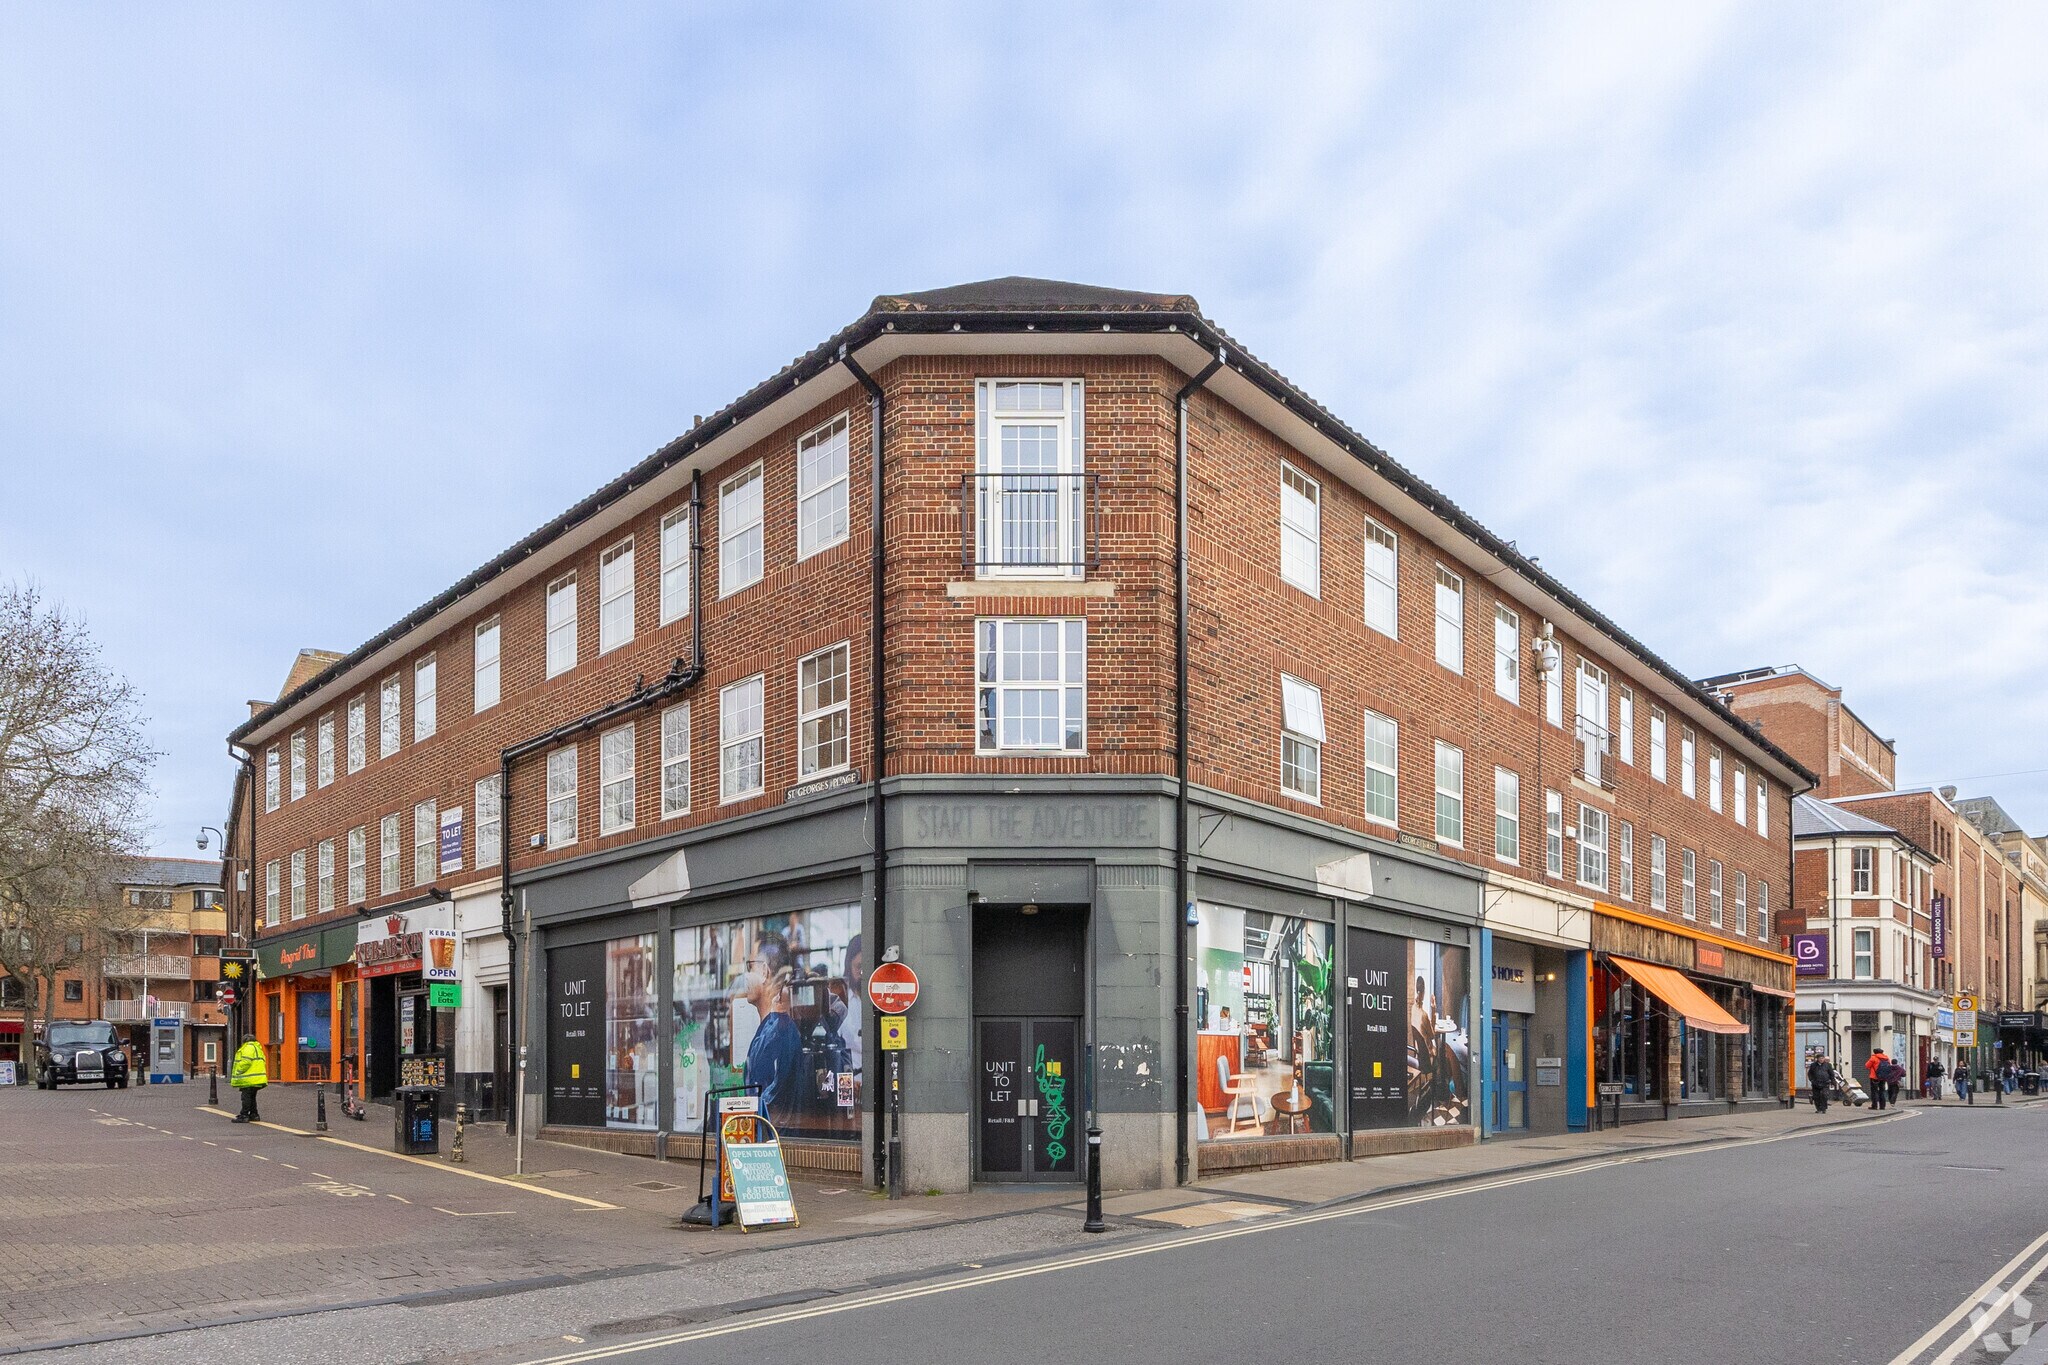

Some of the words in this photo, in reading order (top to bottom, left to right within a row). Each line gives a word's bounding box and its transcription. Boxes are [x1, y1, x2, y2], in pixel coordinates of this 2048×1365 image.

[787, 790, 796, 800] ST
[797, 781, 829, 797] GEORGES
[832, 772, 857, 788] PLACE
[916, 804, 979, 840] START
[985, 804, 1023, 840] THE
[442, 829, 451, 840] TO
[451, 826, 462, 837] LET
[1401, 834, 1420, 846] GEORGE
[429, 929, 456, 937] KEBAB
[355, 936, 398, 964] KEBAB
[400, 931, 423, 957] KIN
[429, 968, 457, 978] OPEN
[1365, 968, 1389, 987] UNIT
[564, 979, 587, 996] UNIT
[437, 990, 454, 998] Uber
[1360, 992, 1374, 1010] TO
[1376, 994, 1393, 1011] LET
[560, 1002, 573, 1018] TO
[575, 1001, 591, 1017] LET
[985, 1061, 1016, 1072] UNIT
[992, 1076, 1010, 1087] TO
[990, 1091, 1011, 1102] LET
[731, 1150, 752, 1158] OPEN
[753, 1150, 777, 1158] TODAY
[743, 1162, 771, 1170] OXFORD
[753, 1185, 778, 1193] STREET
[742, 1192, 762, 1200] FOOD
